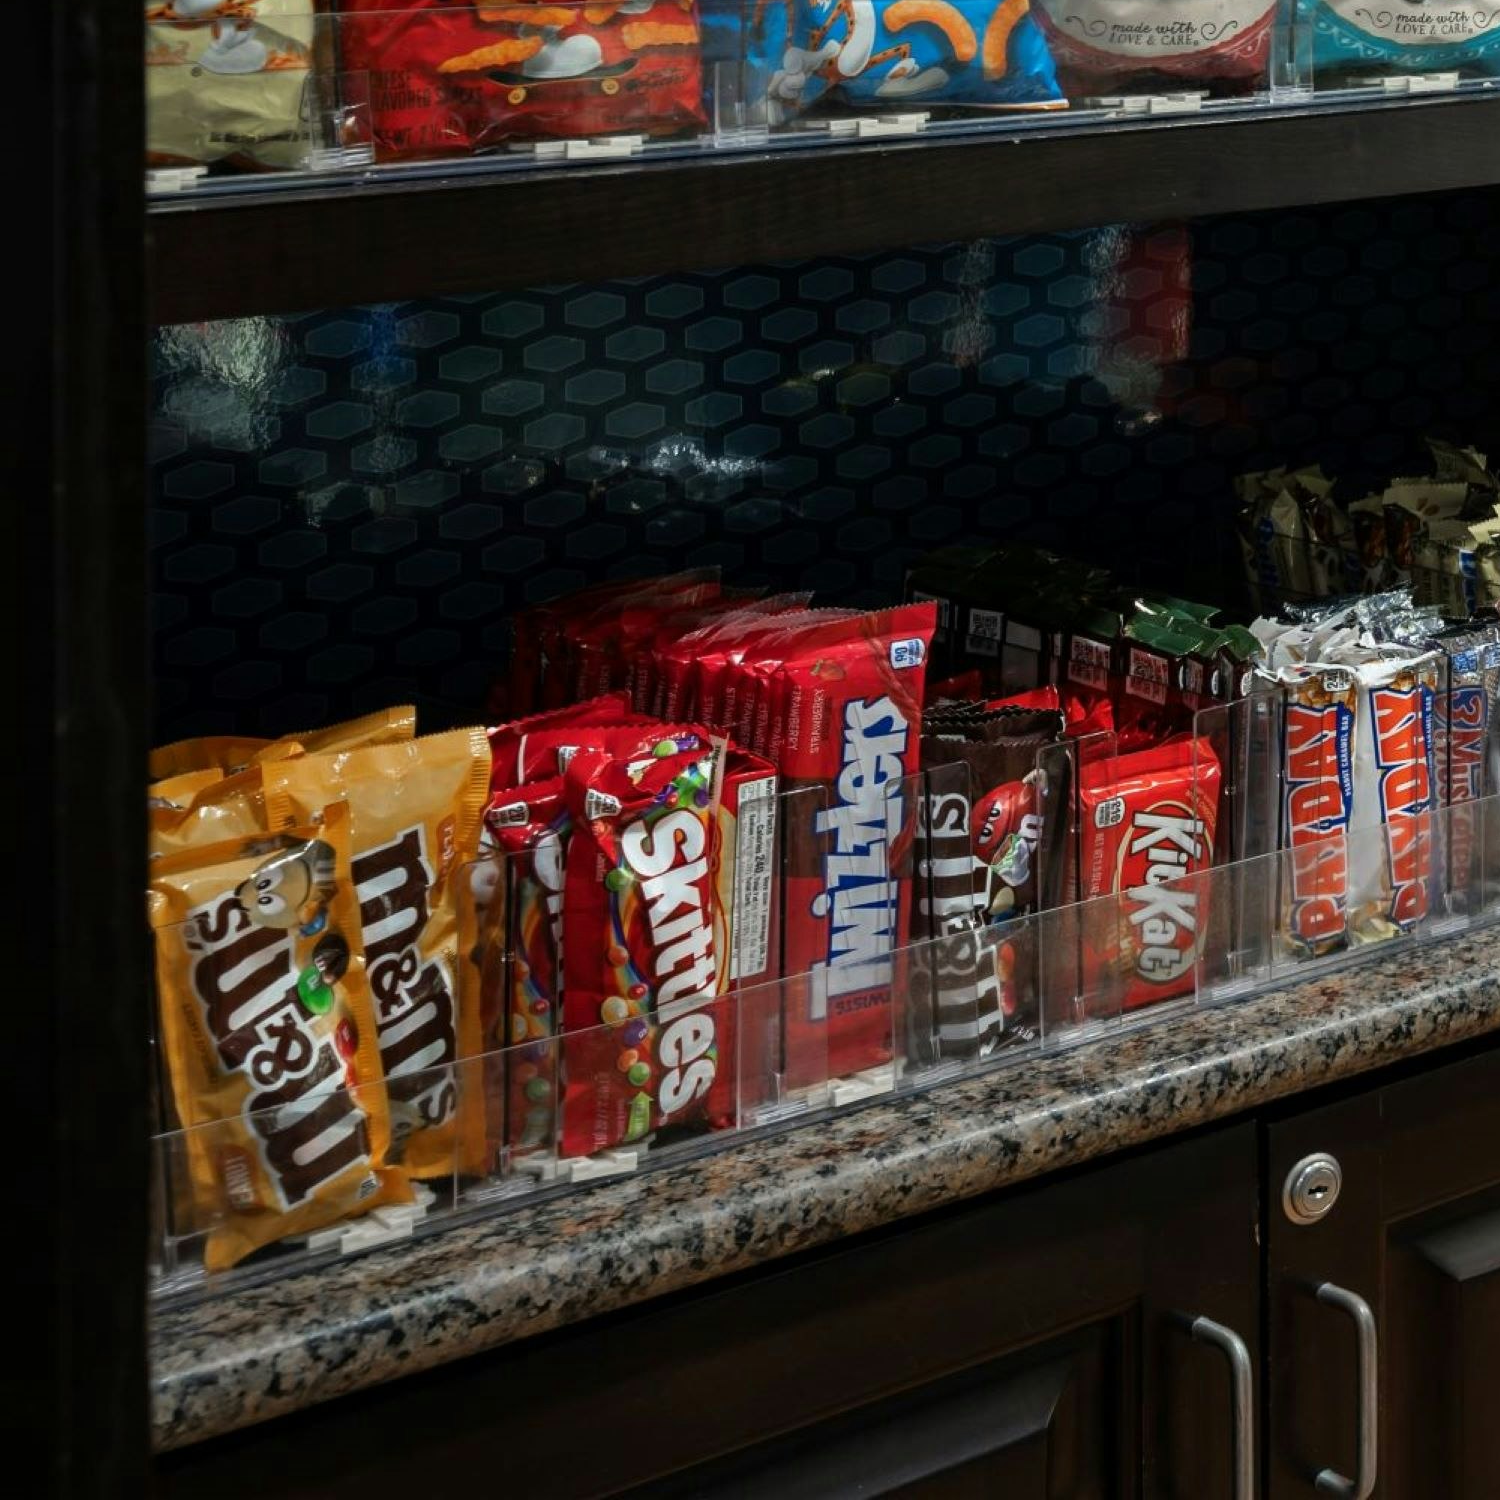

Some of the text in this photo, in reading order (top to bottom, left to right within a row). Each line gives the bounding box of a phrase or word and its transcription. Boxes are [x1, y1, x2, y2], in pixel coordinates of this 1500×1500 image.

[1395, 9, 1471, 25] made with
[1111, 19, 1198, 35] made with
[1441, 23, 1470, 36] CARE
[1160, 33, 1194, 46] CARE
[1372, 693, 1431, 923] PAYDAY
[1287, 703, 1348, 942] PAYDAY
[620, 809, 718, 1115] Skittles
